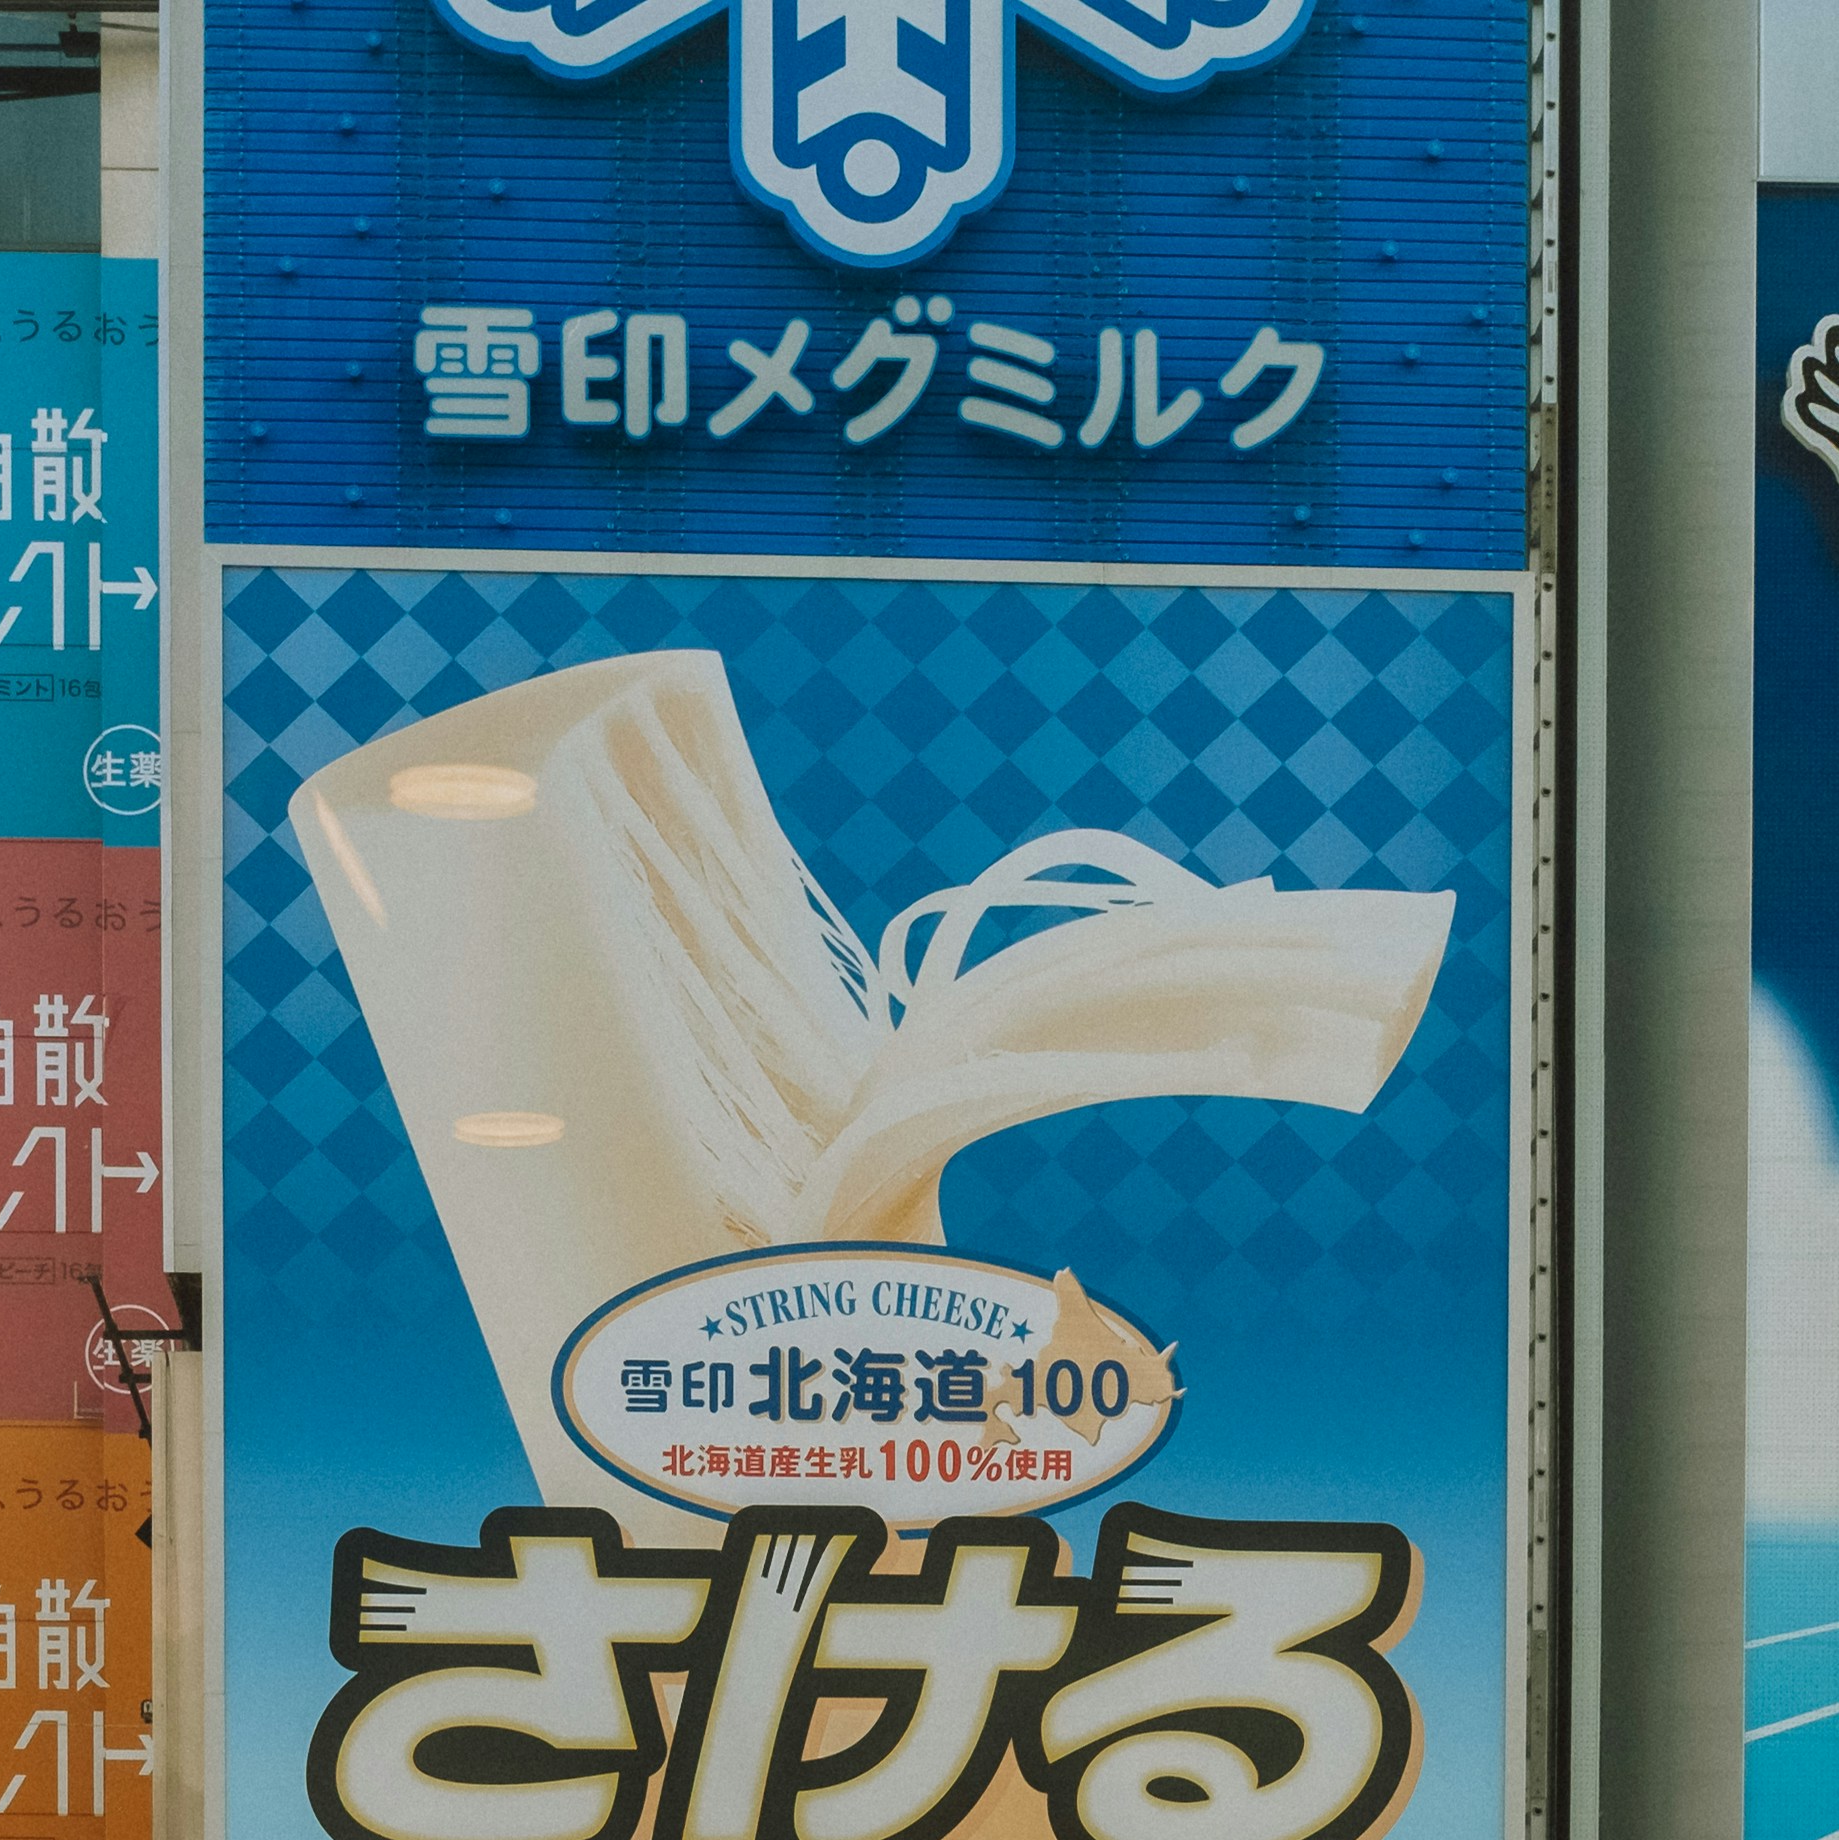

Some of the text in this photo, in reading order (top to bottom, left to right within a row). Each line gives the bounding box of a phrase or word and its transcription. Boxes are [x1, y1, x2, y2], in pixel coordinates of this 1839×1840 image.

[414, 294, 1326, 450] 雪印メグミルク
[91, 751, 161, 788] 生薬
[723, 1280, 1010, 1341] STRING CHEESE
[662, 1439, 1073, 1483] 北海道産生乳100%使用
